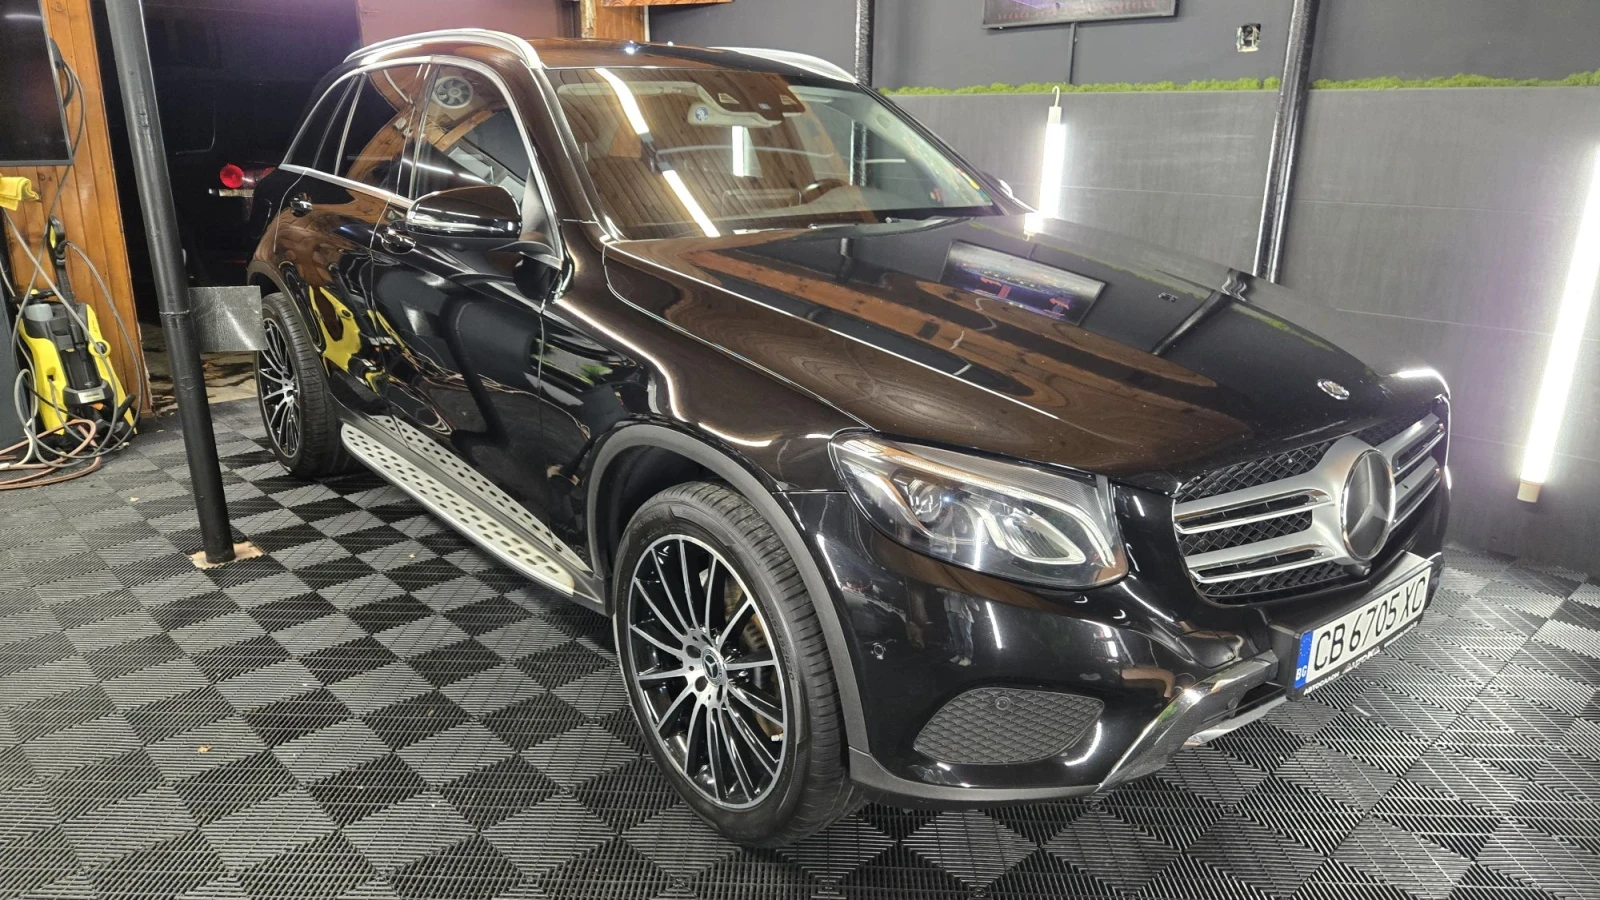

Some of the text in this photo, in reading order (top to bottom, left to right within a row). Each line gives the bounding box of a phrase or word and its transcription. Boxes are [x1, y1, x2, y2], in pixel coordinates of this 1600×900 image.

[1314, 623, 1346, 672] CB
[1349, 592, 1401, 653] 6705
[1400, 576, 1427, 623] XC
[1295, 665, 1308, 681] BG
